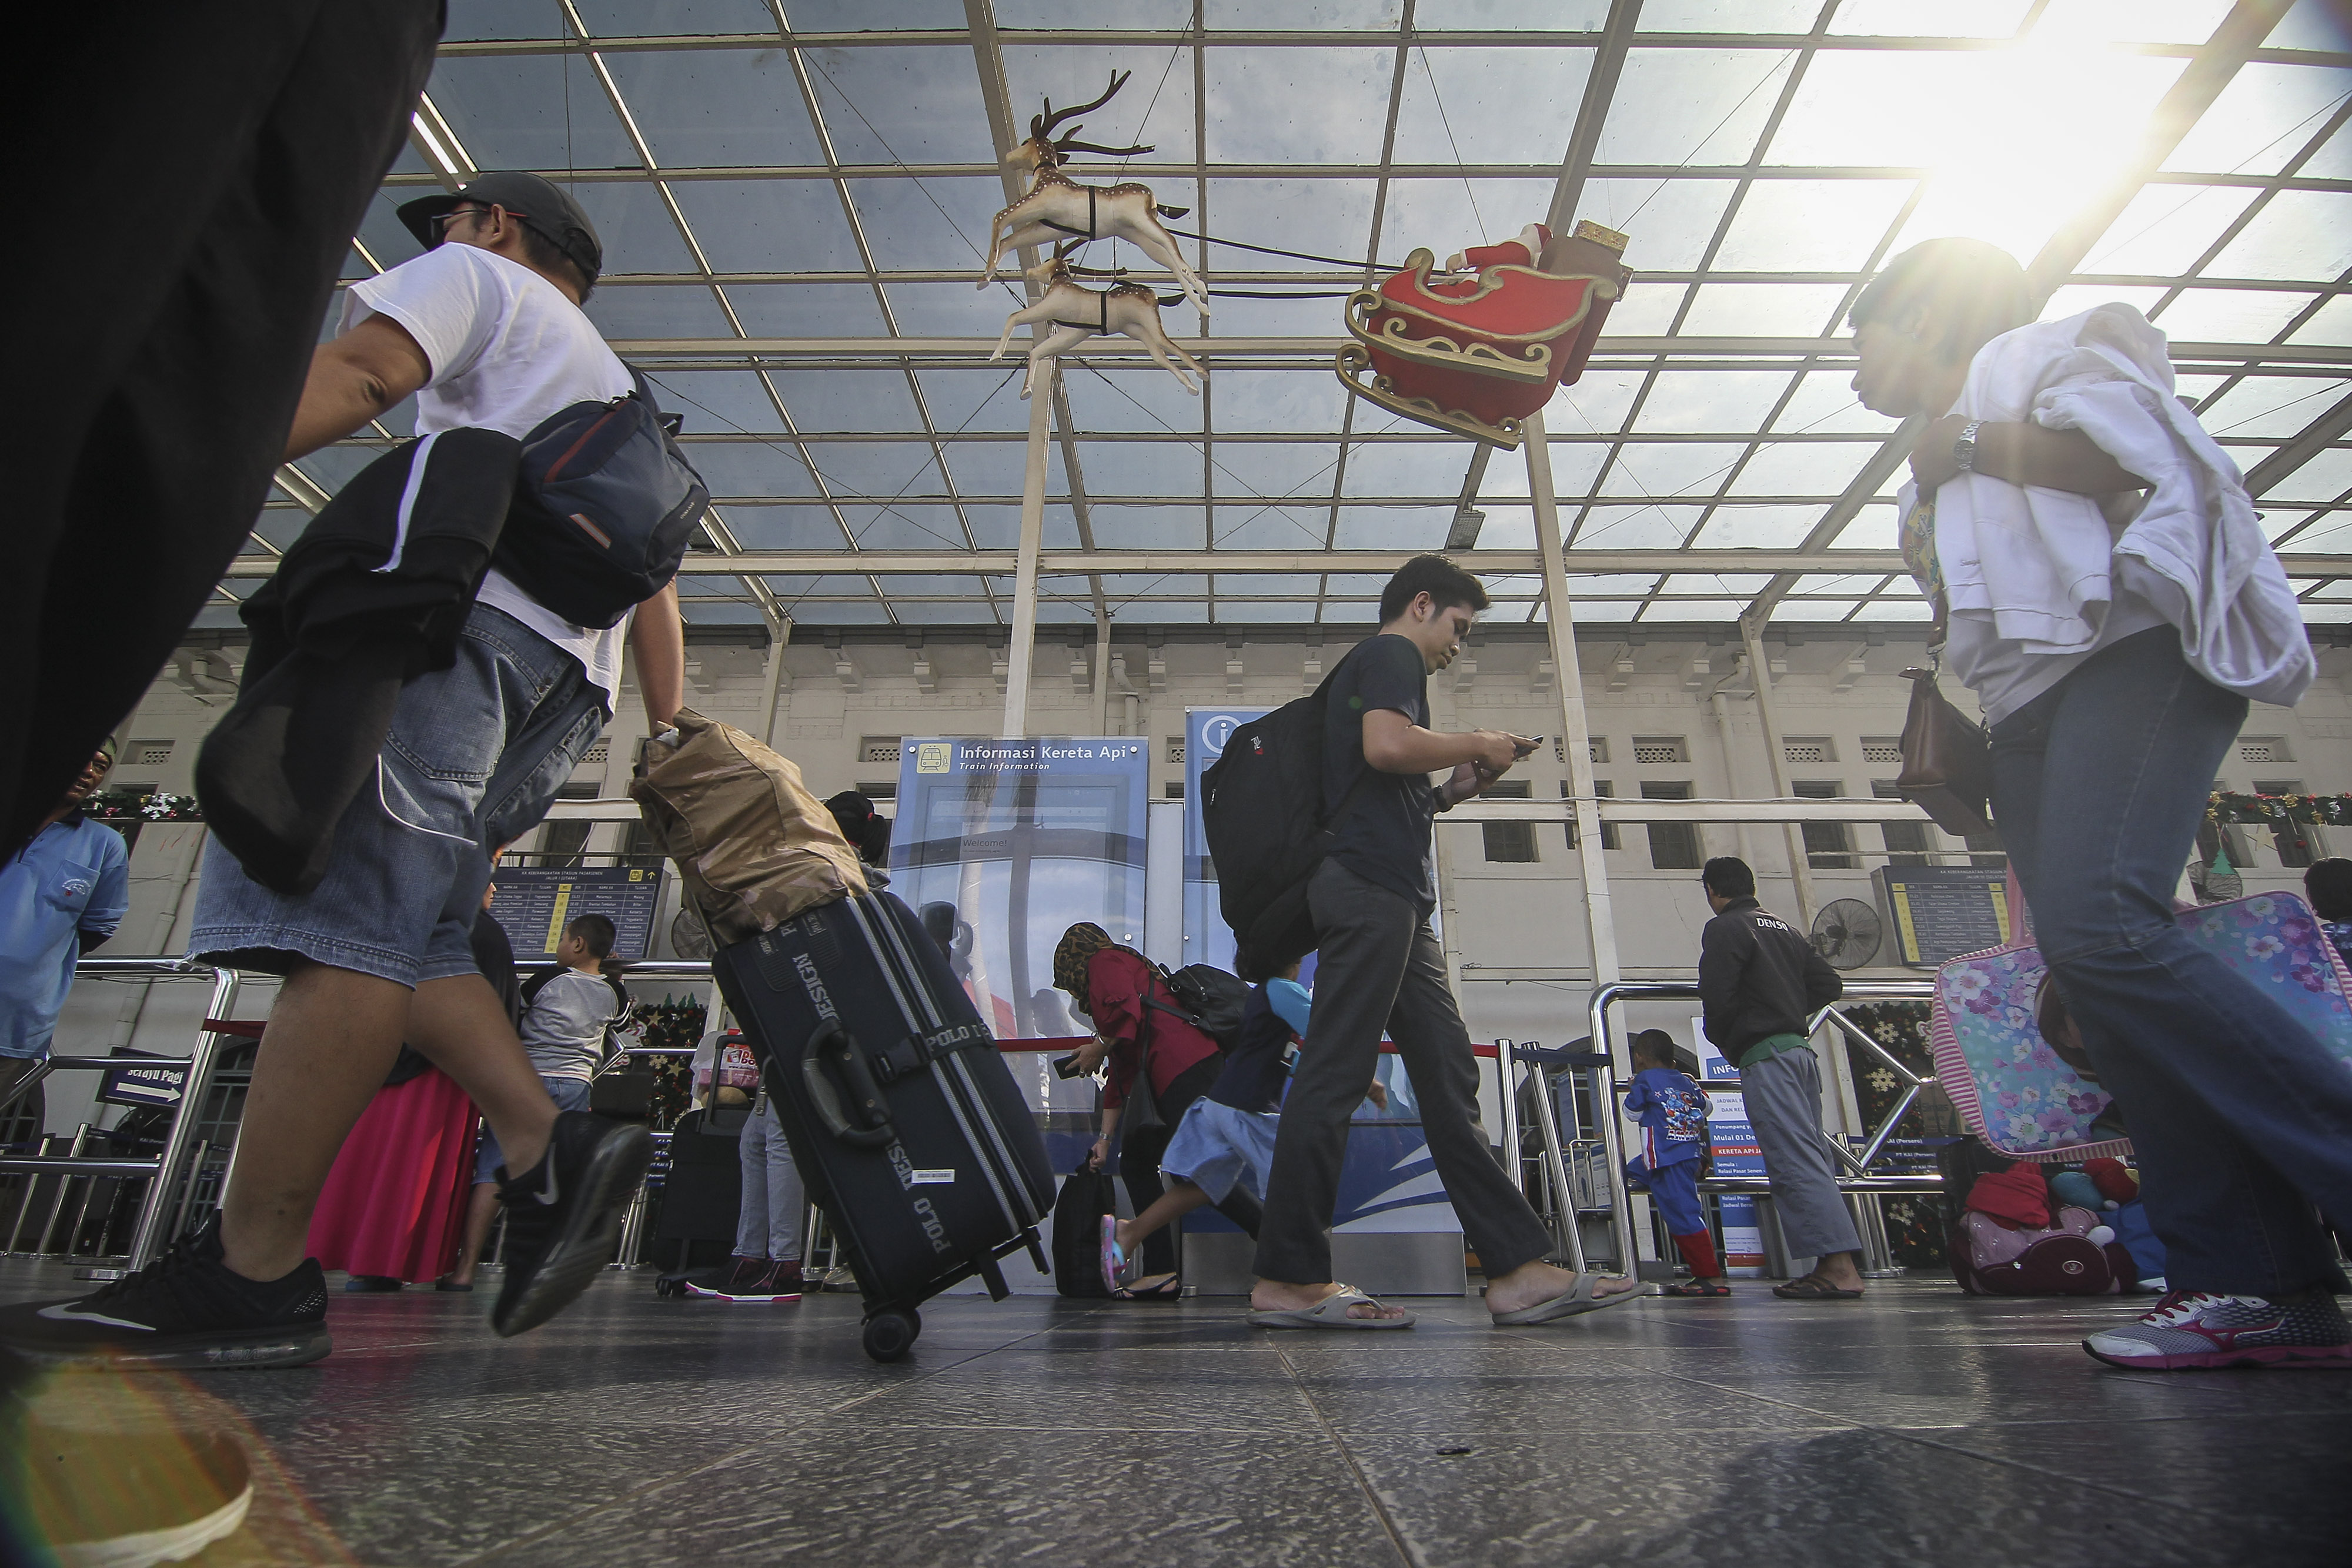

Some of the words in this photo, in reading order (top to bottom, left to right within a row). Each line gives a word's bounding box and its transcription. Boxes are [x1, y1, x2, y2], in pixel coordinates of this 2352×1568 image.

[960, 745, 1035, 759] Informasi
[1041, 745, 1093, 759] Kereta
[1099, 745, 1126, 761] Api
[989, 762, 1050, 771] Information
[1756, 918, 1788, 931] DENSO
[161, 1069, 184, 1084] Pagi
[914, 1198, 952, 1253] POLO
